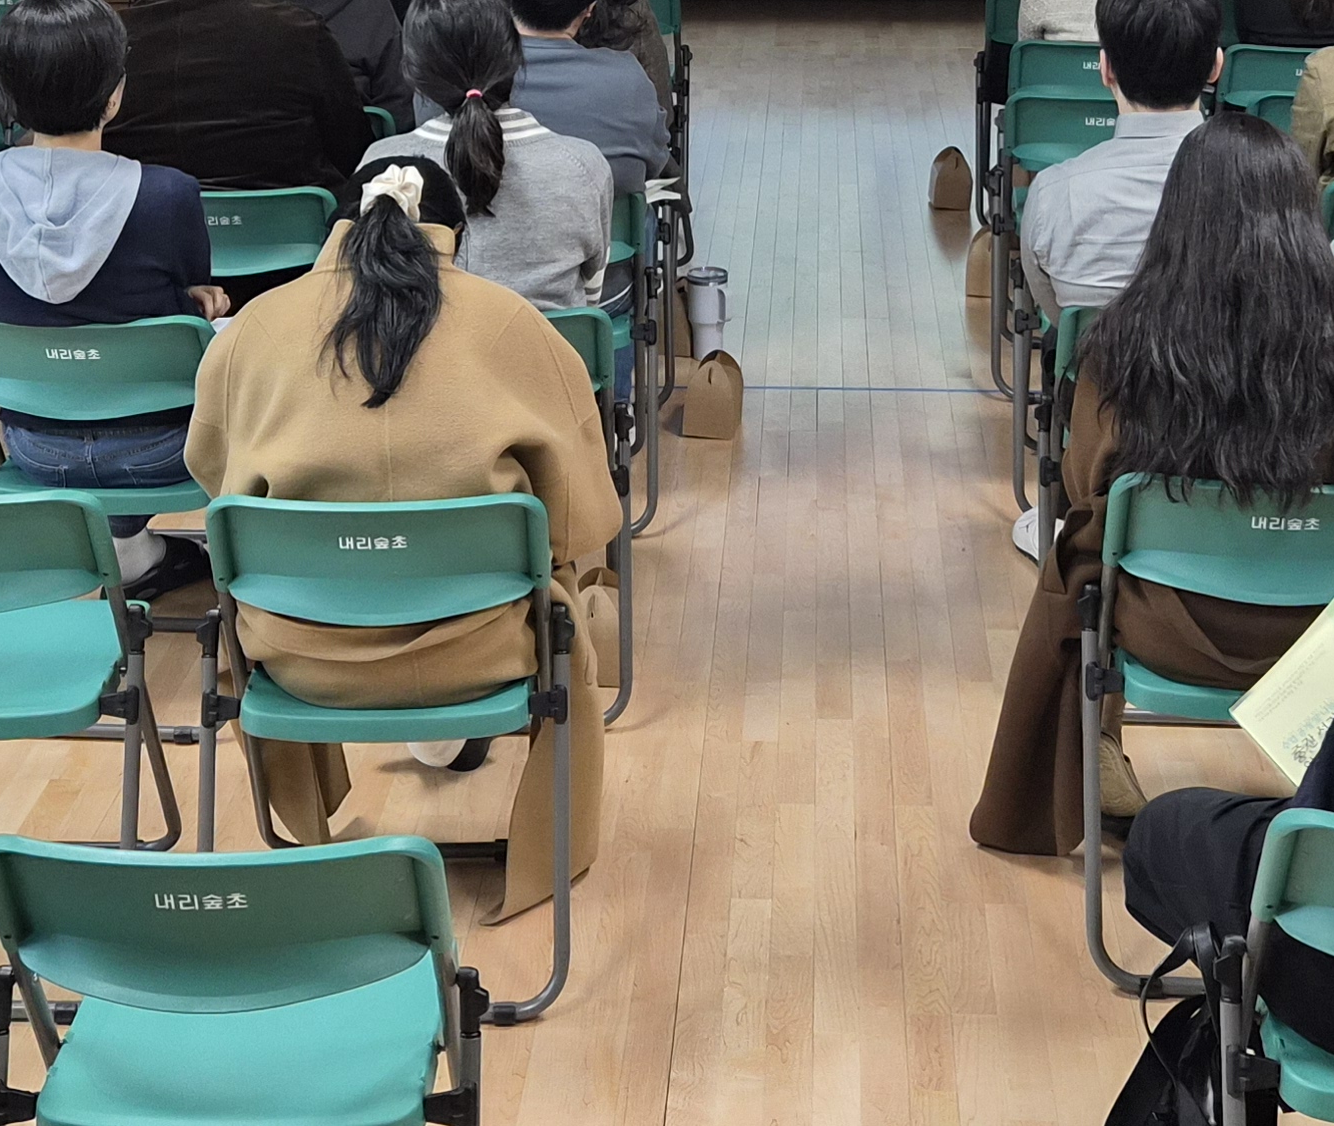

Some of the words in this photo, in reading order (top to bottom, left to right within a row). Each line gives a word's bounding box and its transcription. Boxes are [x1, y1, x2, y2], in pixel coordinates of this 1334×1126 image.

[1083, 61, 1100, 70] 내리
[1085, 117, 1115, 127] 내리숲
[207, 215, 242, 226] 리숲초
[46, 349, 100, 359] 내리숲초
[1251, 517, 1319, 530] 내리숲초
[339, 536, 407, 549] 내리숲초
[155, 893, 248, 910] 내리숲초
